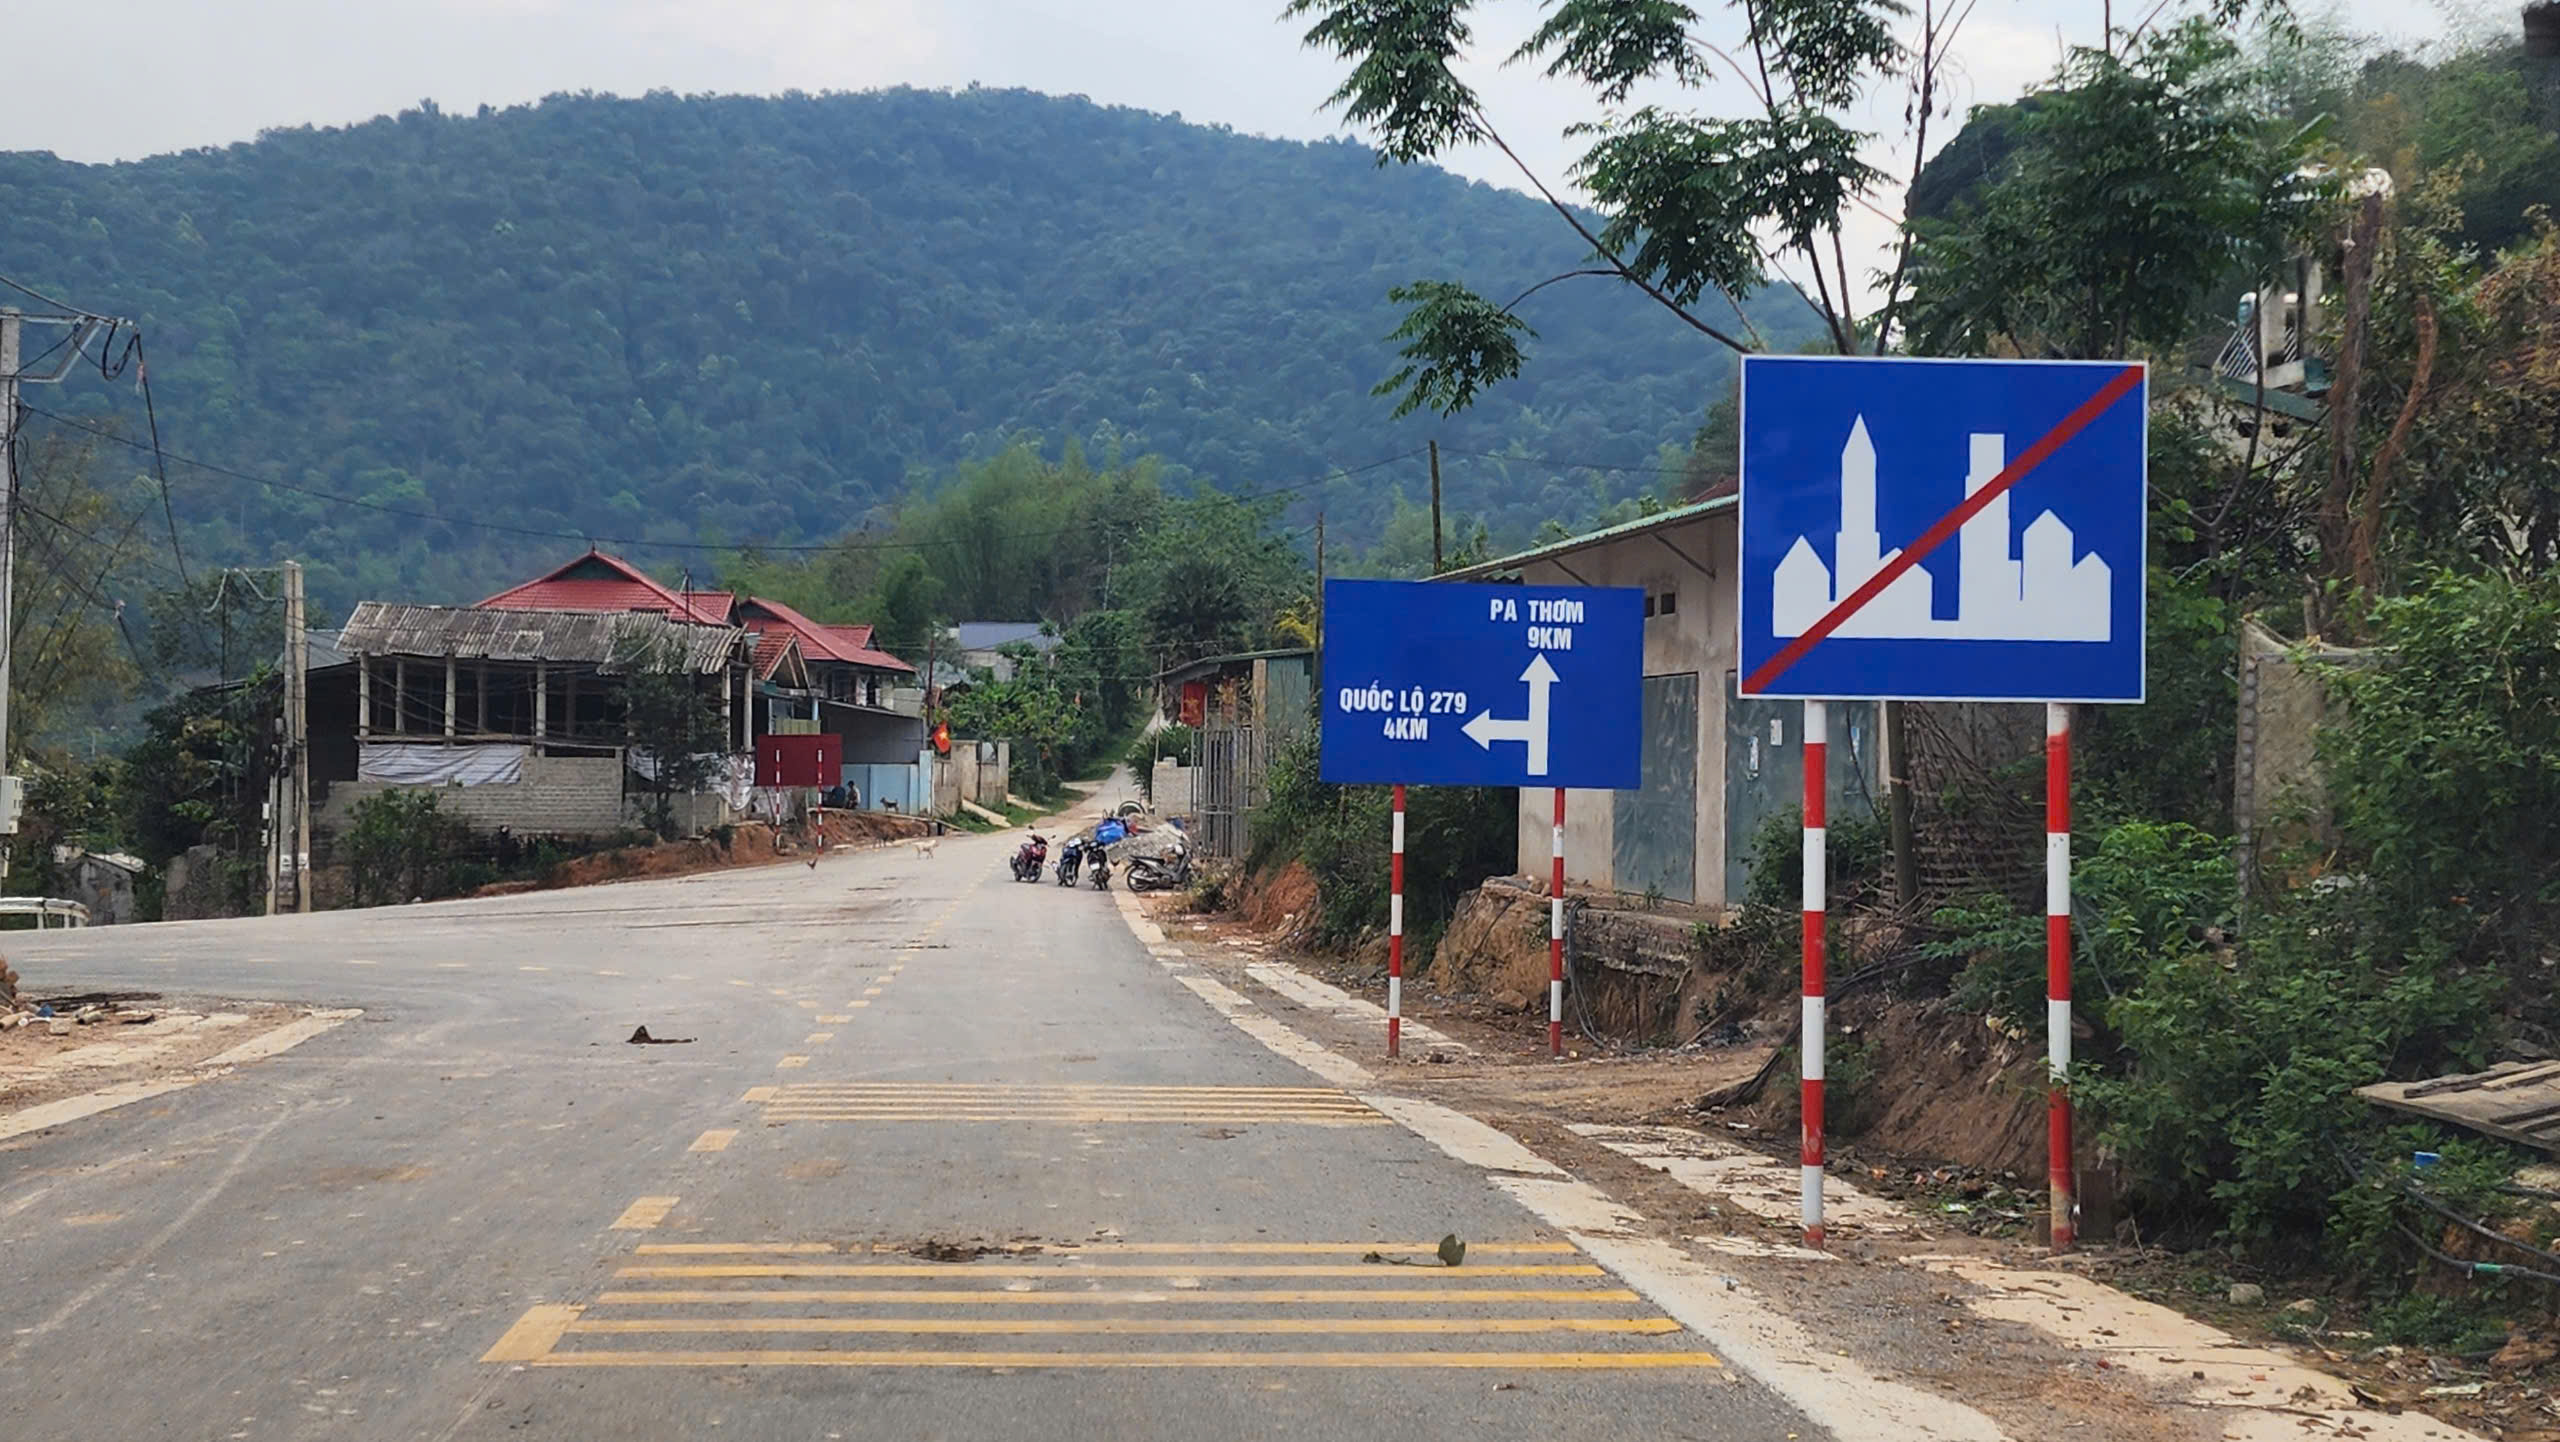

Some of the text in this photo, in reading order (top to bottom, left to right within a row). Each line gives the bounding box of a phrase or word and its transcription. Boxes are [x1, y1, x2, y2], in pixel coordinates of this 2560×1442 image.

[1490, 598, 1584, 624] PA THƠM
[1527, 626, 1572, 650] 9KM
[1339, 679, 1467, 717] QUỐC LỘ 279
[1383, 717, 1428, 741] 4KM
